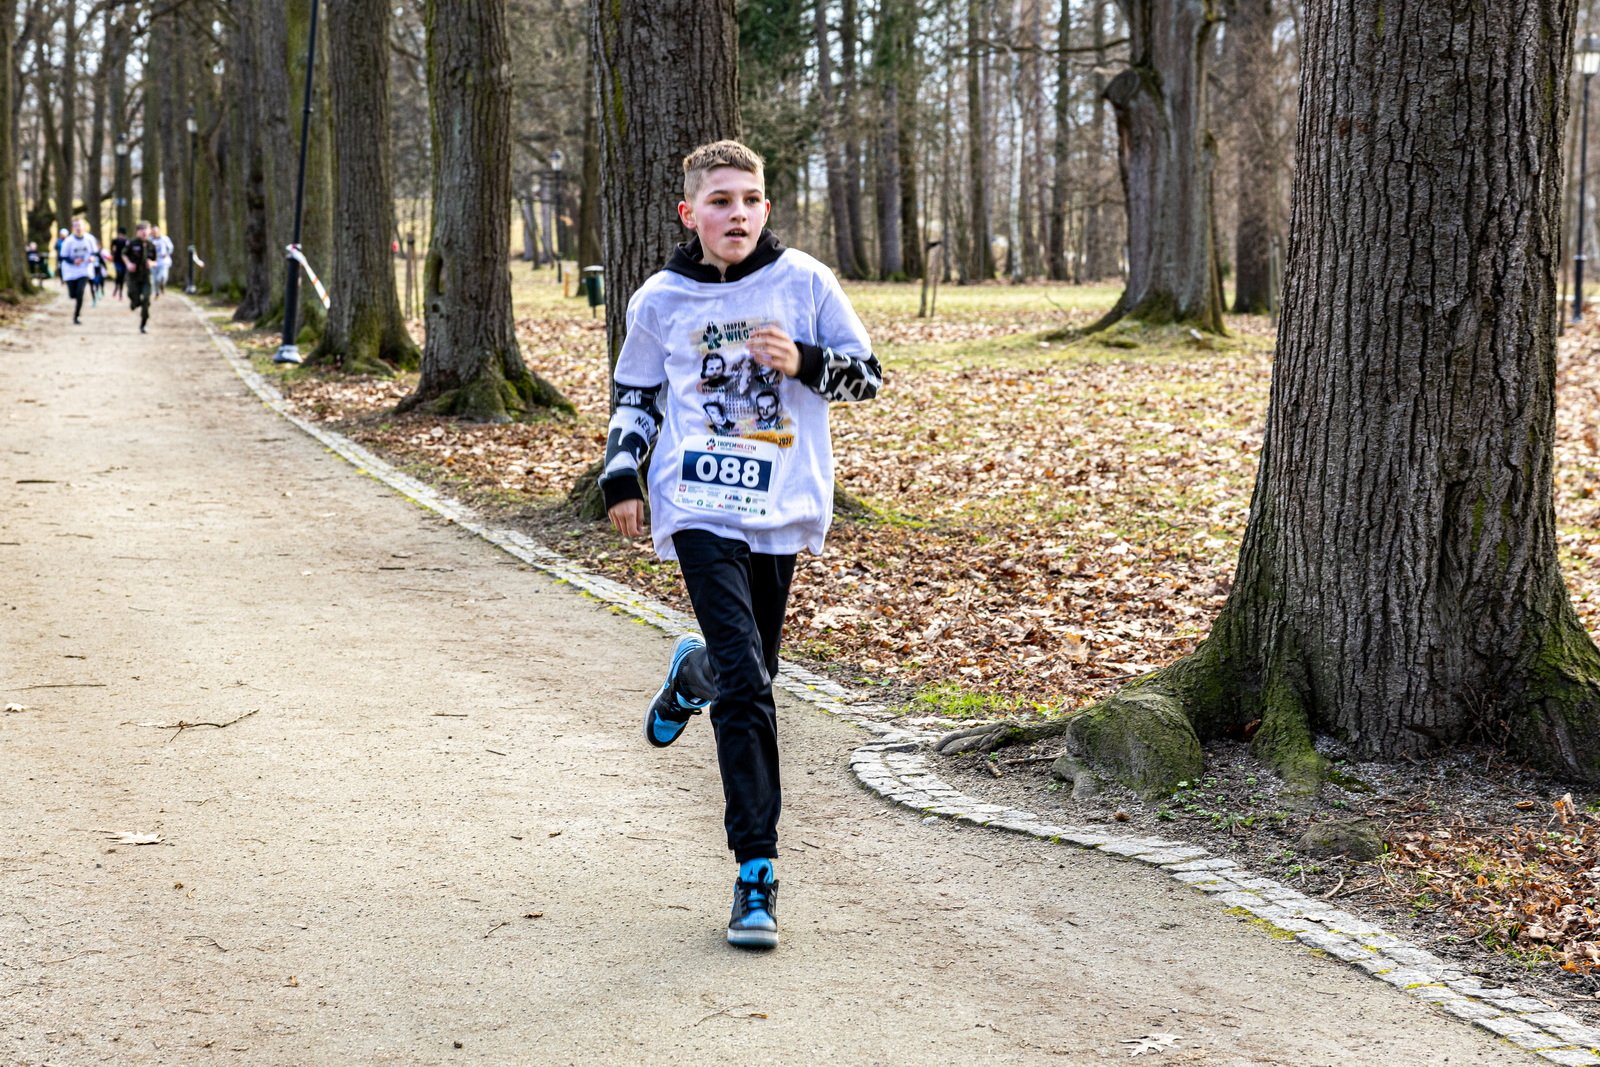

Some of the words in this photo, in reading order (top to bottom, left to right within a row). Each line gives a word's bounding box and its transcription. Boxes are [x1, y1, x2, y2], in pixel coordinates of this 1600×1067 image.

[723, 321, 747, 331] TROPEM
[725, 327, 754, 342] WILC
[695, 454, 761, 488] 088
